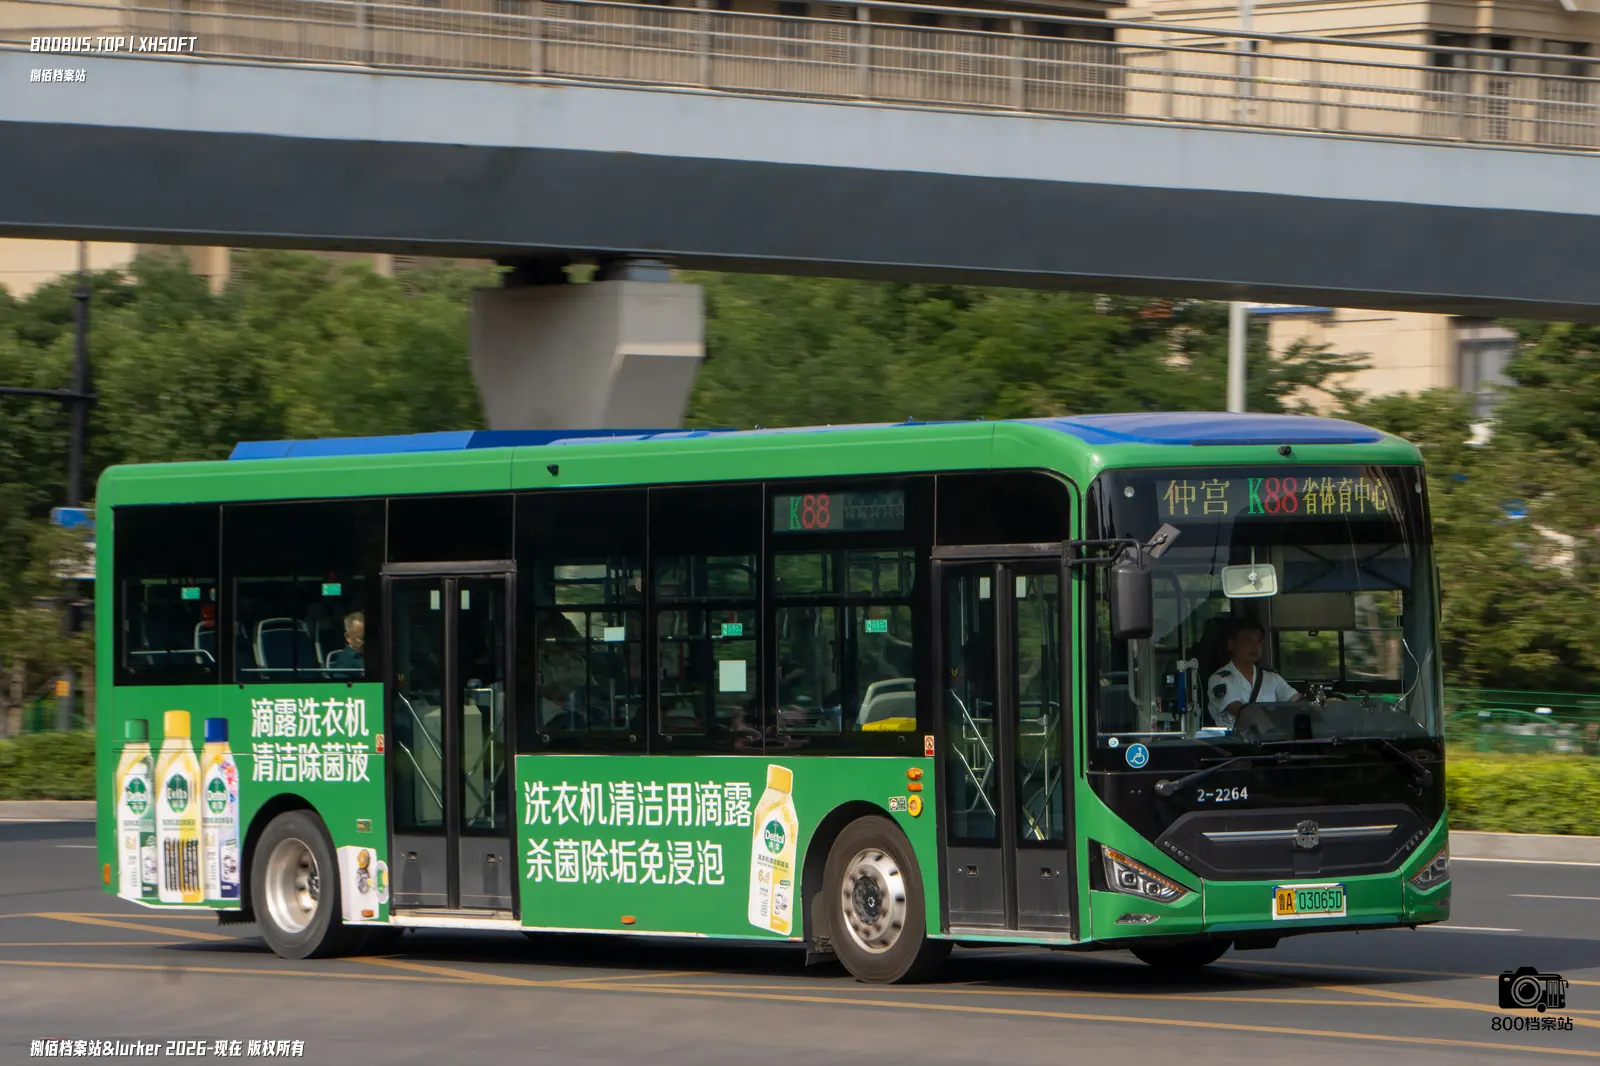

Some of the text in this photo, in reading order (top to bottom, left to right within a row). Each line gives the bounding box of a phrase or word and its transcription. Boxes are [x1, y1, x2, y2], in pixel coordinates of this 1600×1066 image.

[790, 494, 830, 529] K88
[1164, 477, 1388, 515] 仲宫 K88 省体育中心
[251, 697, 369, 737] 滴露洗衣机
[252, 742, 370, 782] 清洁除菌液
[524, 780, 753, 827] 洗衣机清洁用滴露
[1197, 786, 1249, 802] 2-2264
[526, 838, 725, 886] 杀菌除垢免浸泡
[1299, 890, 1342, 910] 03065D
